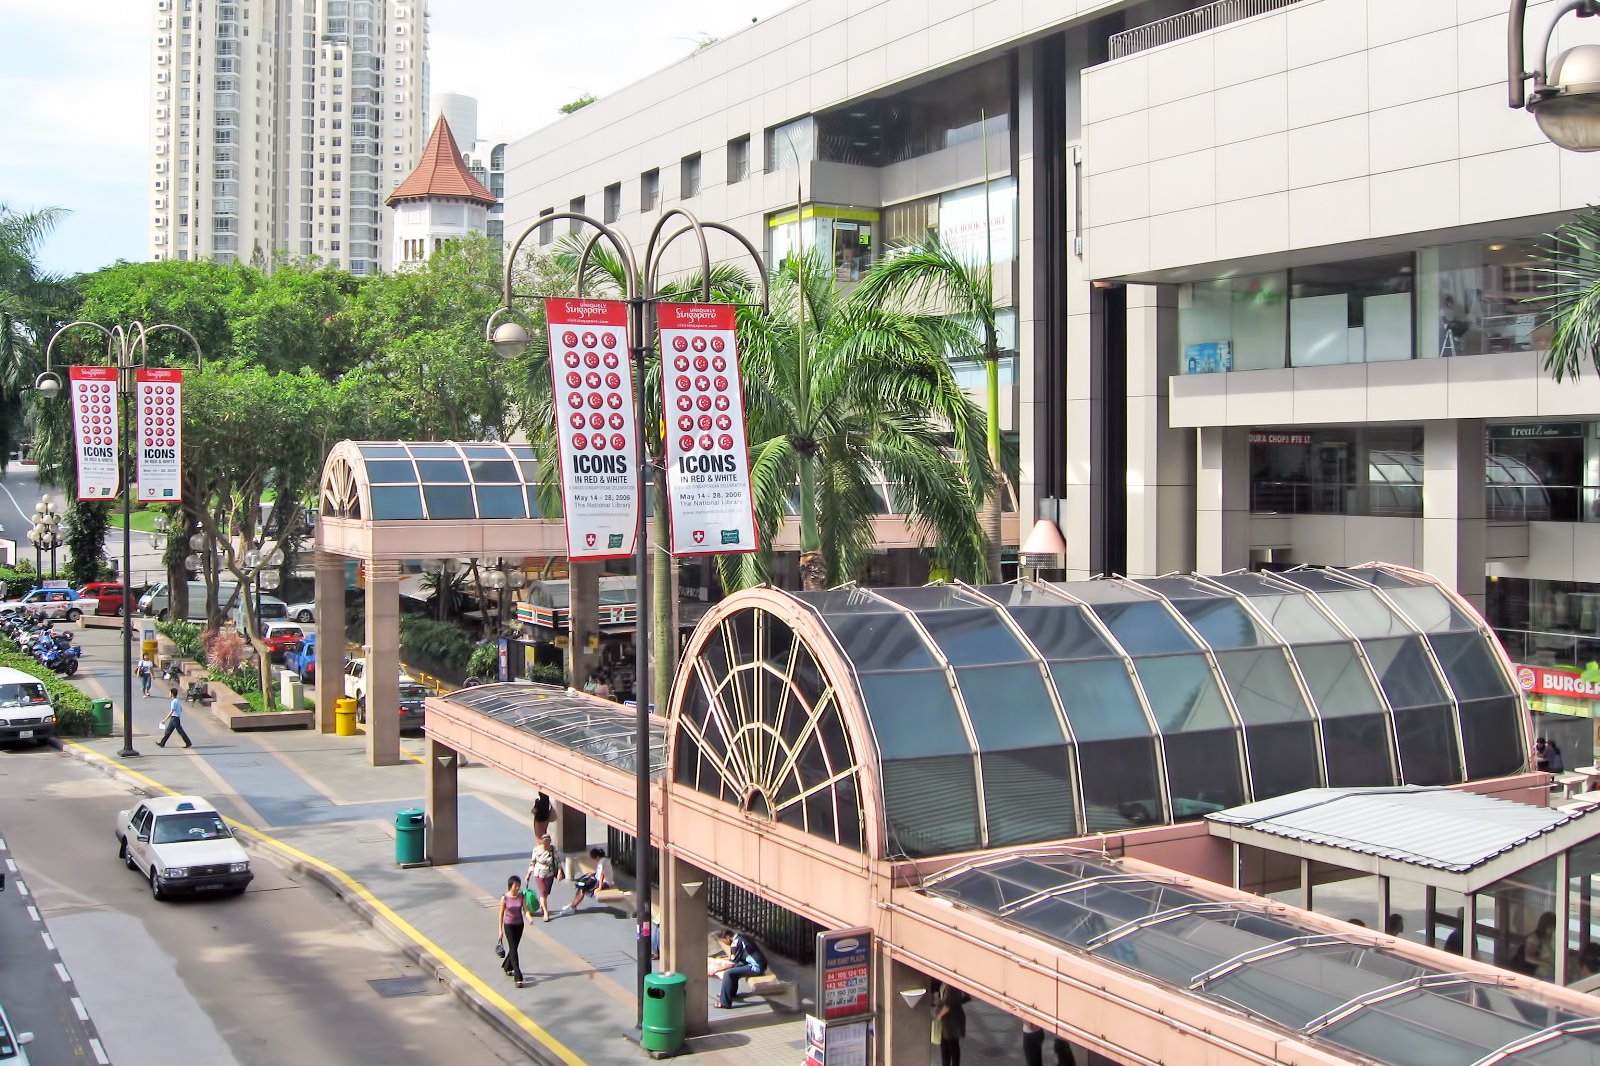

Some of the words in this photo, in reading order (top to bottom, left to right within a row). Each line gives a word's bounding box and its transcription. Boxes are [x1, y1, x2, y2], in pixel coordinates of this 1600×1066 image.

[960, 222, 980, 233] BOOK
[982, 216, 1005, 228] SORE
[566, 302, 607, 318] Singapore
[676, 307, 716, 323] Singapore
[84, 447, 113, 457] ICONS
[144, 449, 175, 458] ICONS
[573, 455, 627, 473] ICONS
[679, 454, 736, 473] ICONS
[613, 608, 622, 621] 7
